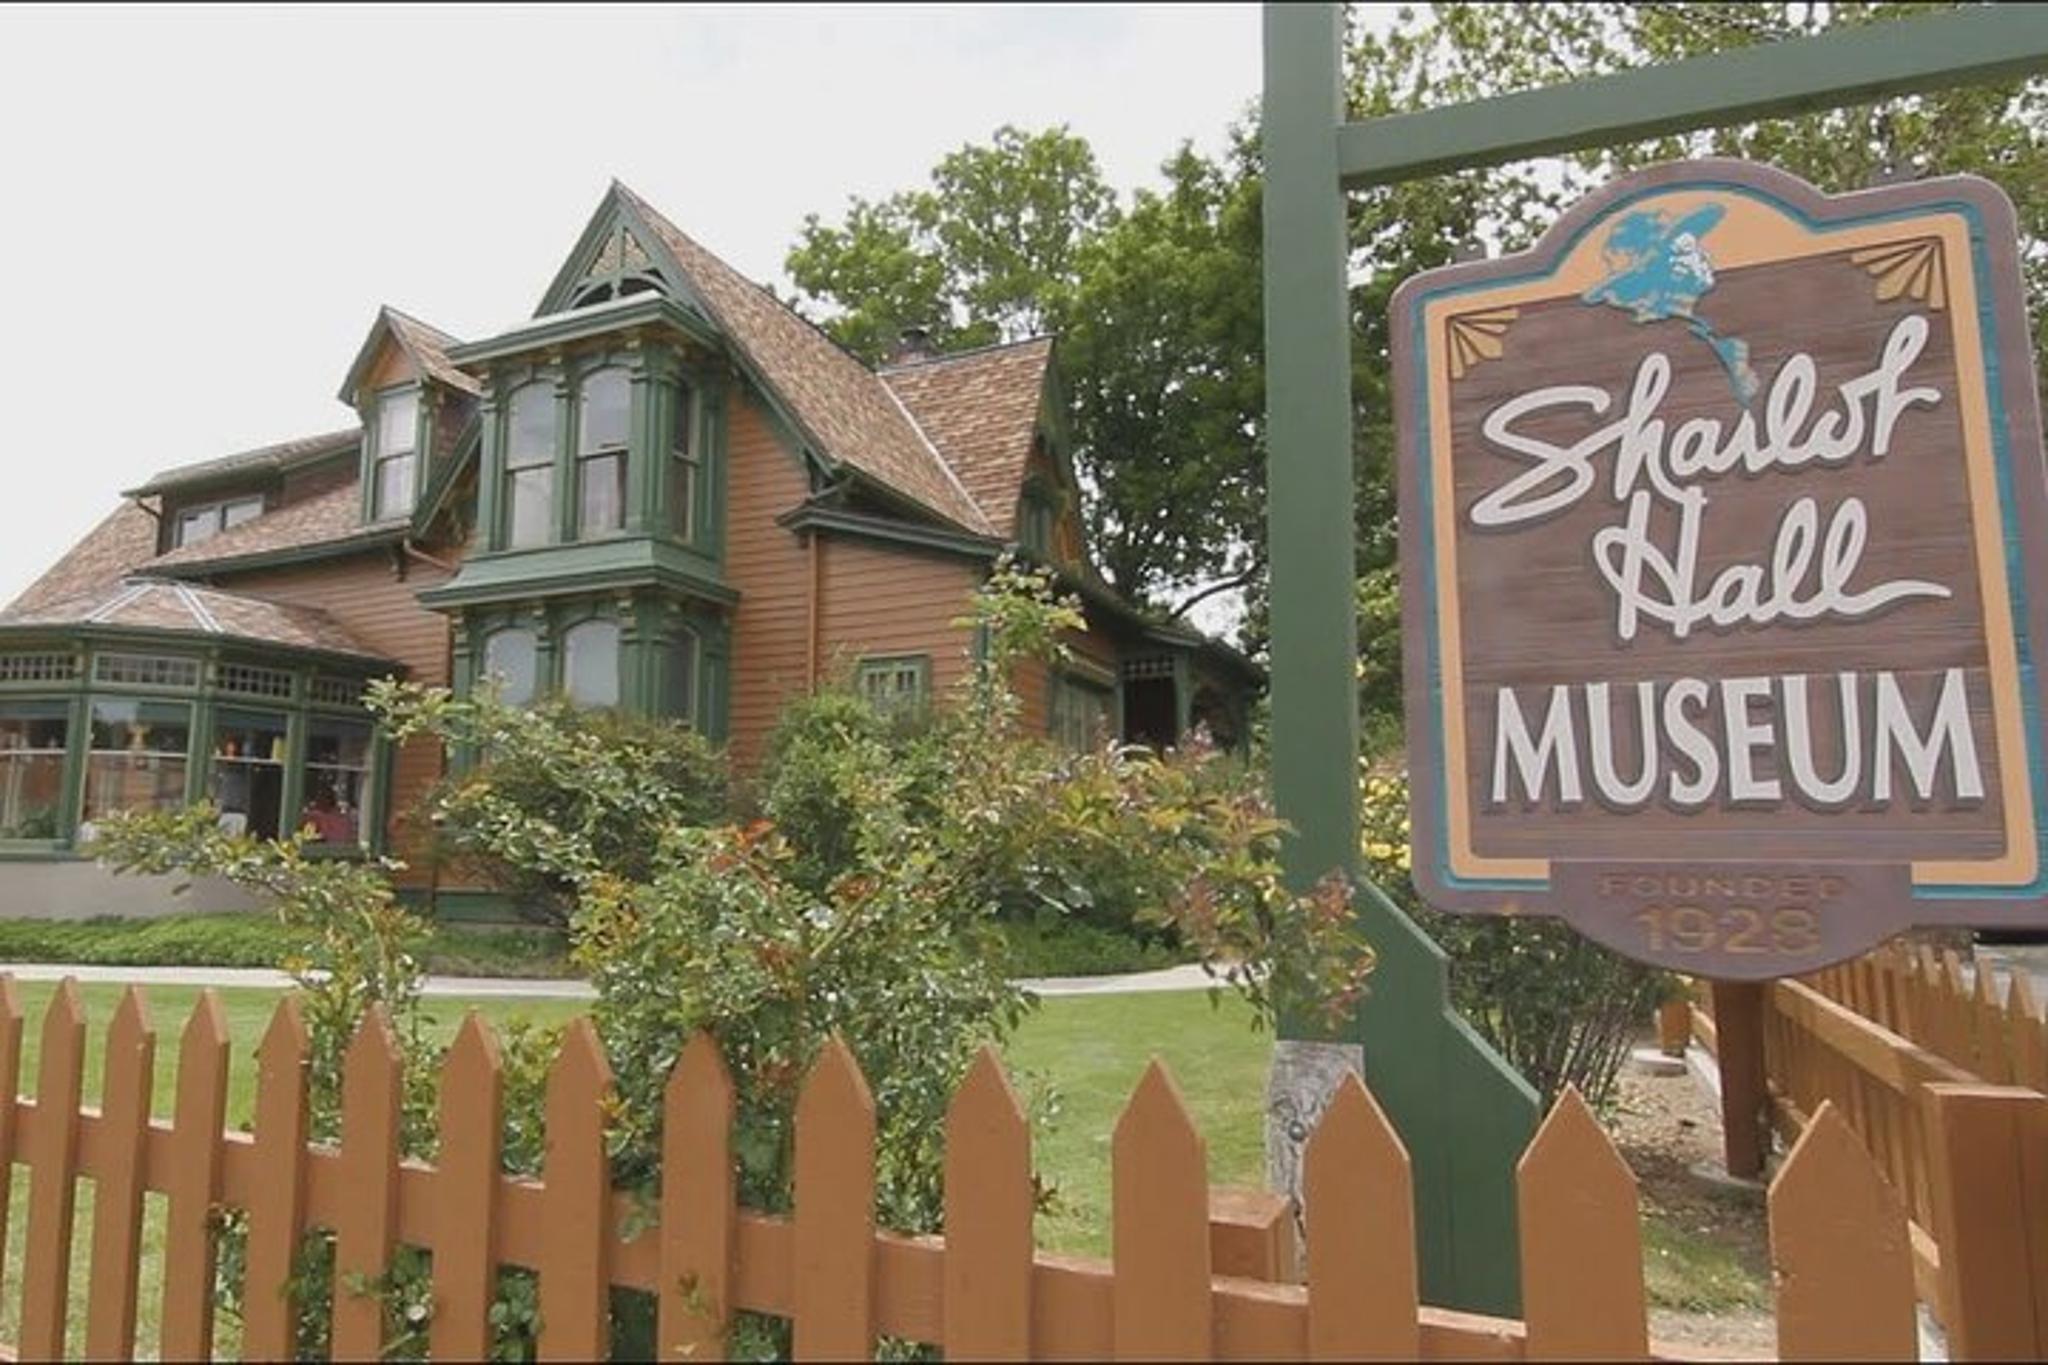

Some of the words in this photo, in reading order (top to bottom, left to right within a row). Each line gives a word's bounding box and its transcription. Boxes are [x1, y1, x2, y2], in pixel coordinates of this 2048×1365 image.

[1470, 314, 1941, 526] Sharlot
[1593, 490, 1952, 640] Hall
[1491, 668, 1984, 805] MUSEUM
[1601, 873, 1848, 899] FOUNDED
[1636, 904, 1821, 955] 1928
